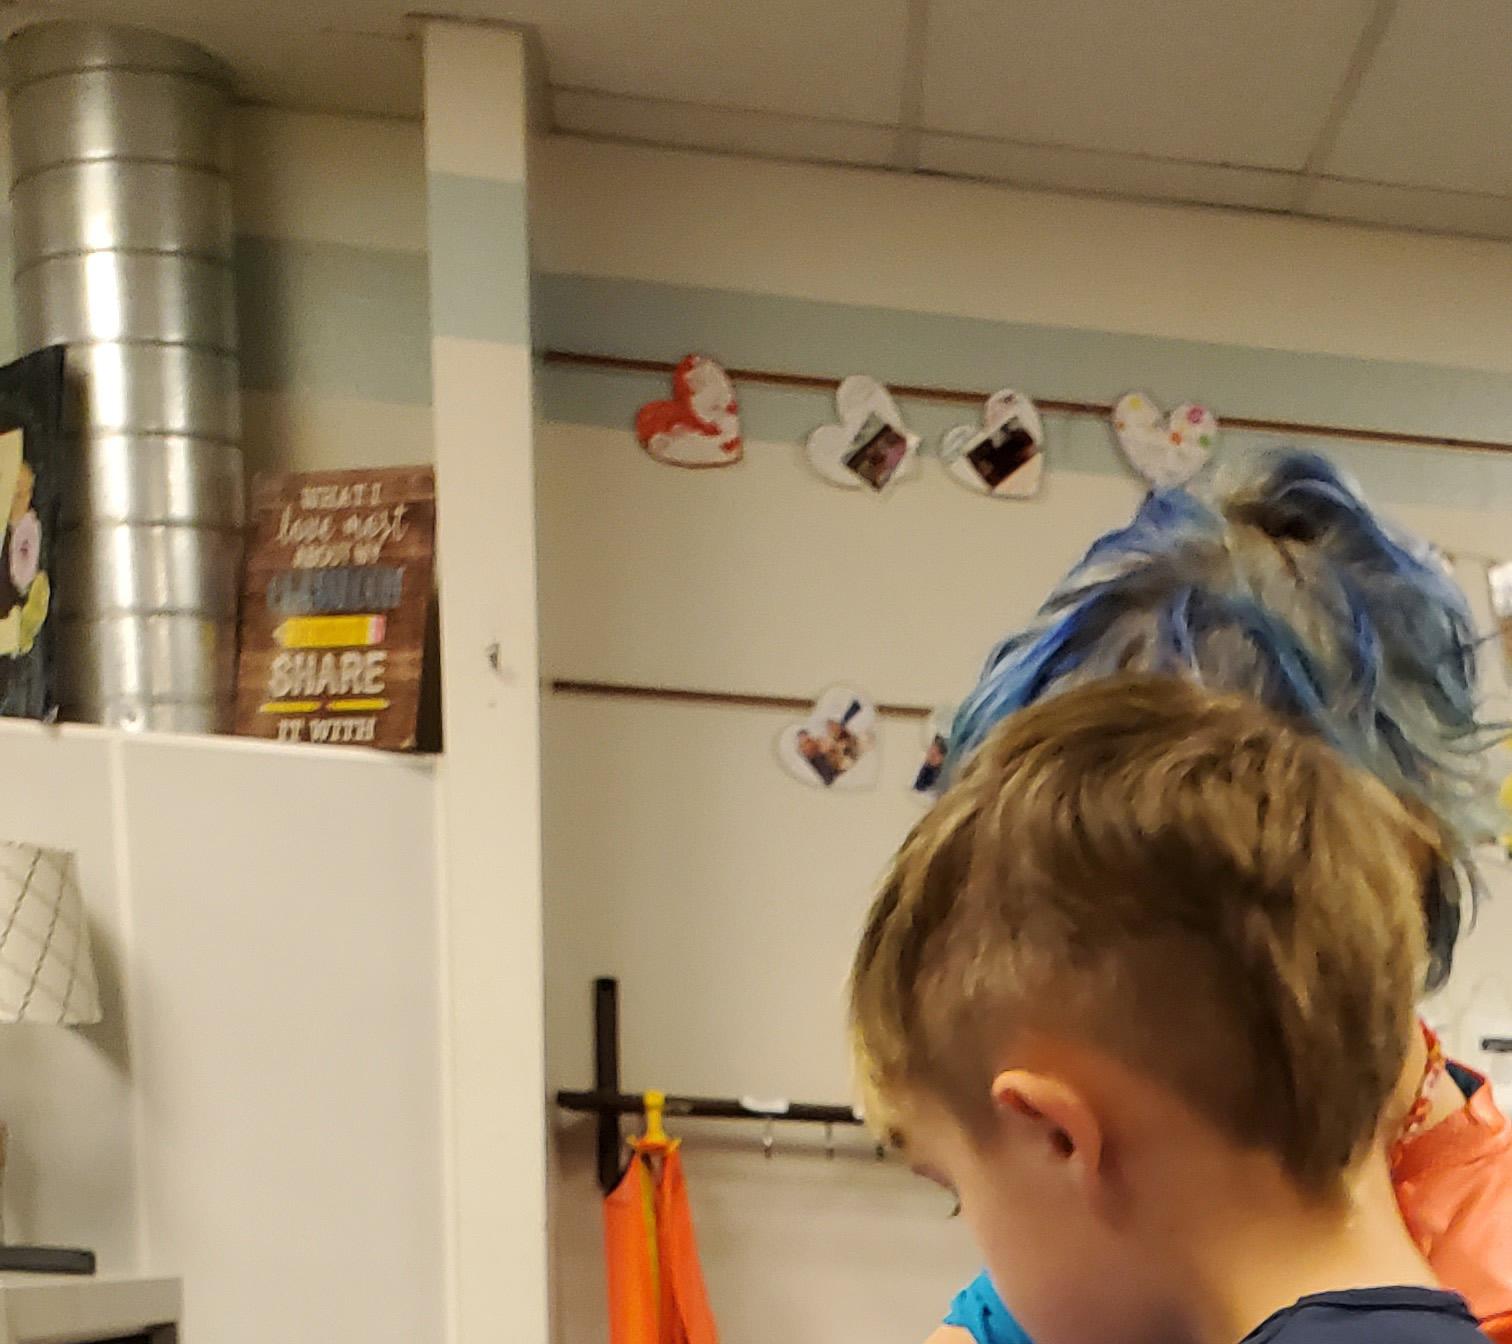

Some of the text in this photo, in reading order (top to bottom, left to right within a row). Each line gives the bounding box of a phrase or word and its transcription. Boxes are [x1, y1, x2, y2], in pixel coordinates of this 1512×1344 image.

[268, 650, 388, 698] SHARE
[277, 716, 378, 743] IT WITH
